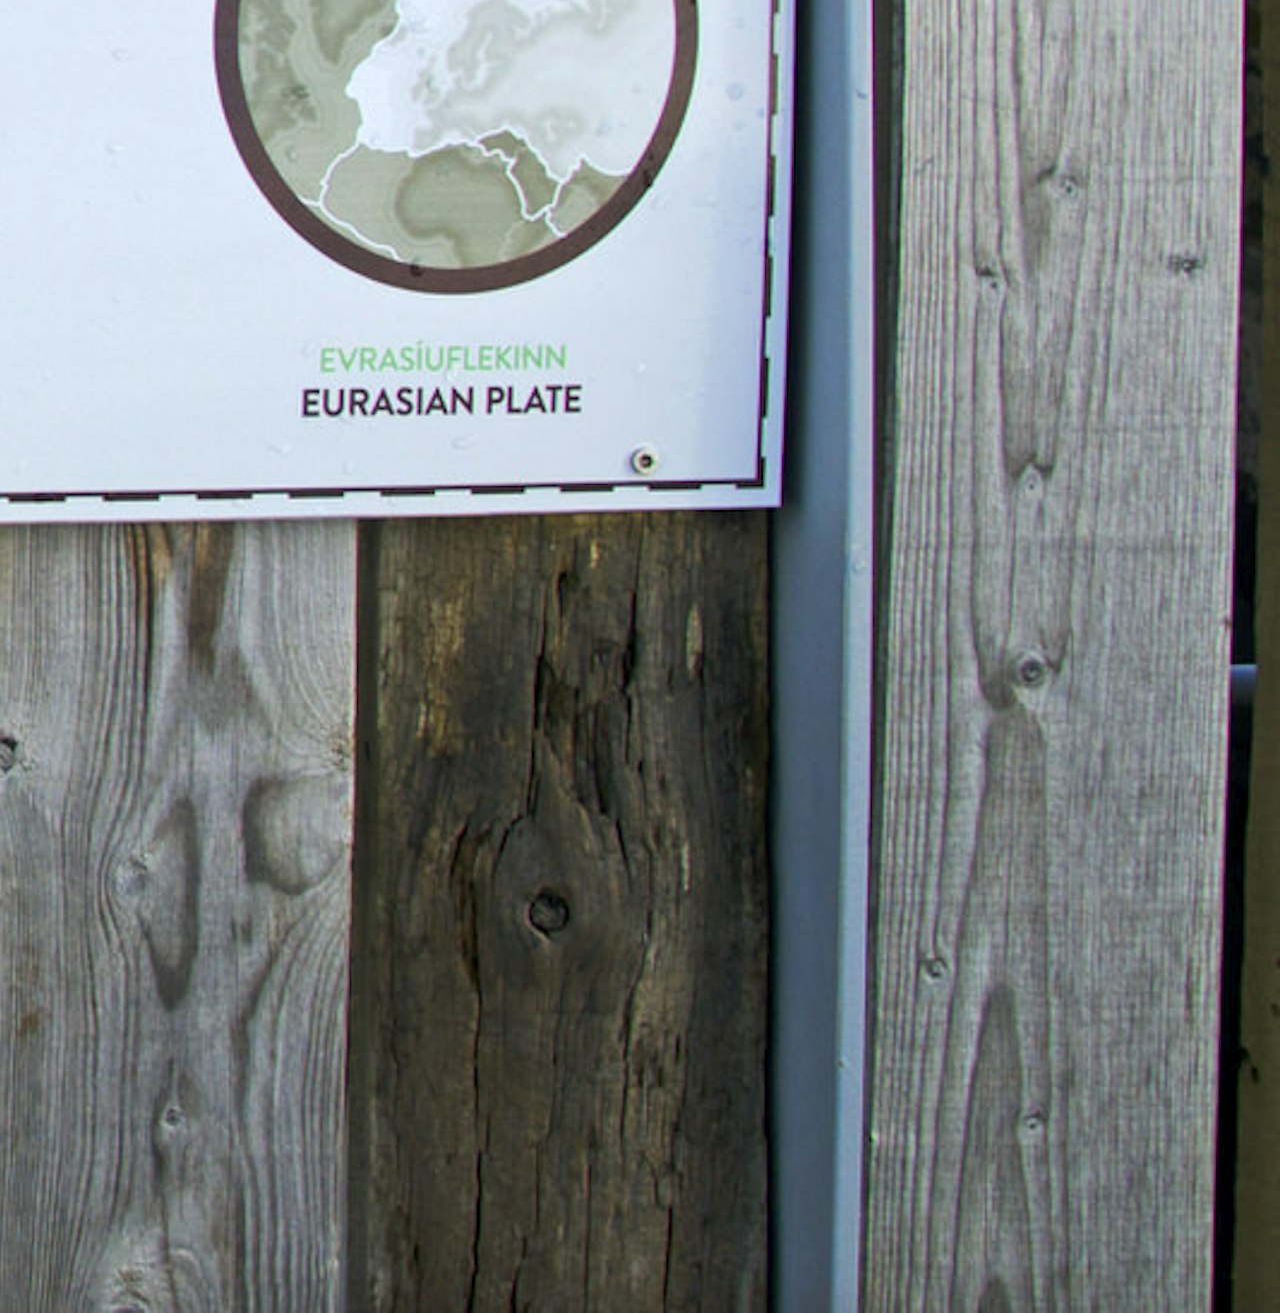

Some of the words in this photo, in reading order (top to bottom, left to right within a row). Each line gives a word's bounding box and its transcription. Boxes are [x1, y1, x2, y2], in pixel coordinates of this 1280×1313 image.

[319, 340, 568, 373] EVRASÍUFLEKINN
[302, 386, 474, 417] EURASIAN
[486, 385, 582, 414] PLATE
